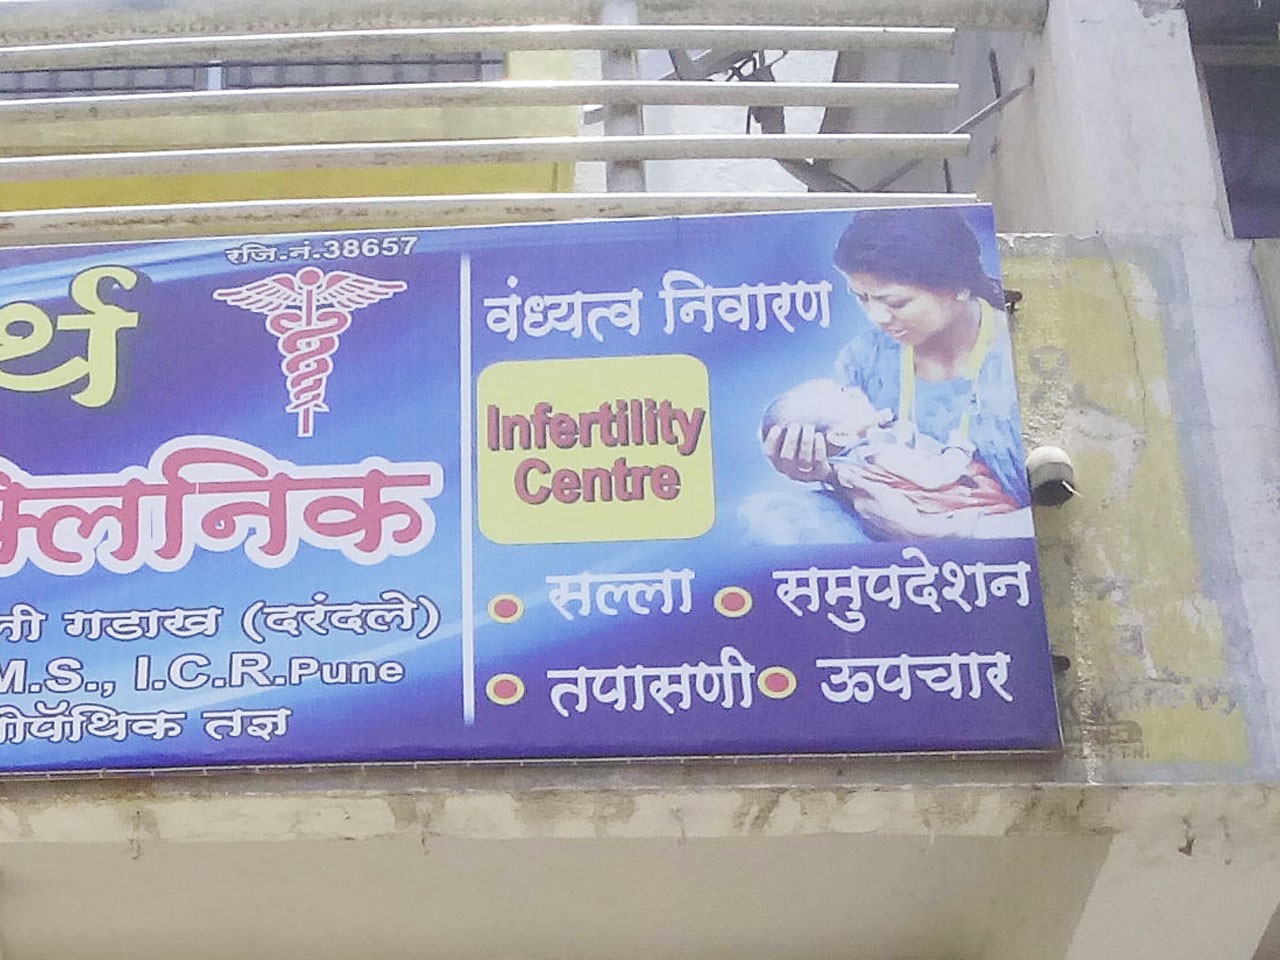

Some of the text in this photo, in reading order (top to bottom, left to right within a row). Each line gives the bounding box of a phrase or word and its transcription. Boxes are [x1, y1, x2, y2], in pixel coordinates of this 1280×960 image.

[484, 270, 833, 342] वंध्यत्व निवारण
[487, 398, 706, 458] Infertility
[514, 457, 682, 506] Centre
[63, 606, 224, 640] गडाख
[242, 590, 441, 642] (दरंदले)
[545, 546, 1031, 633] सल्ला समुपदेशन
[547, 646, 1014, 719] तपासणी ऊपचार
[202, 708, 292, 741] तज्ञ
